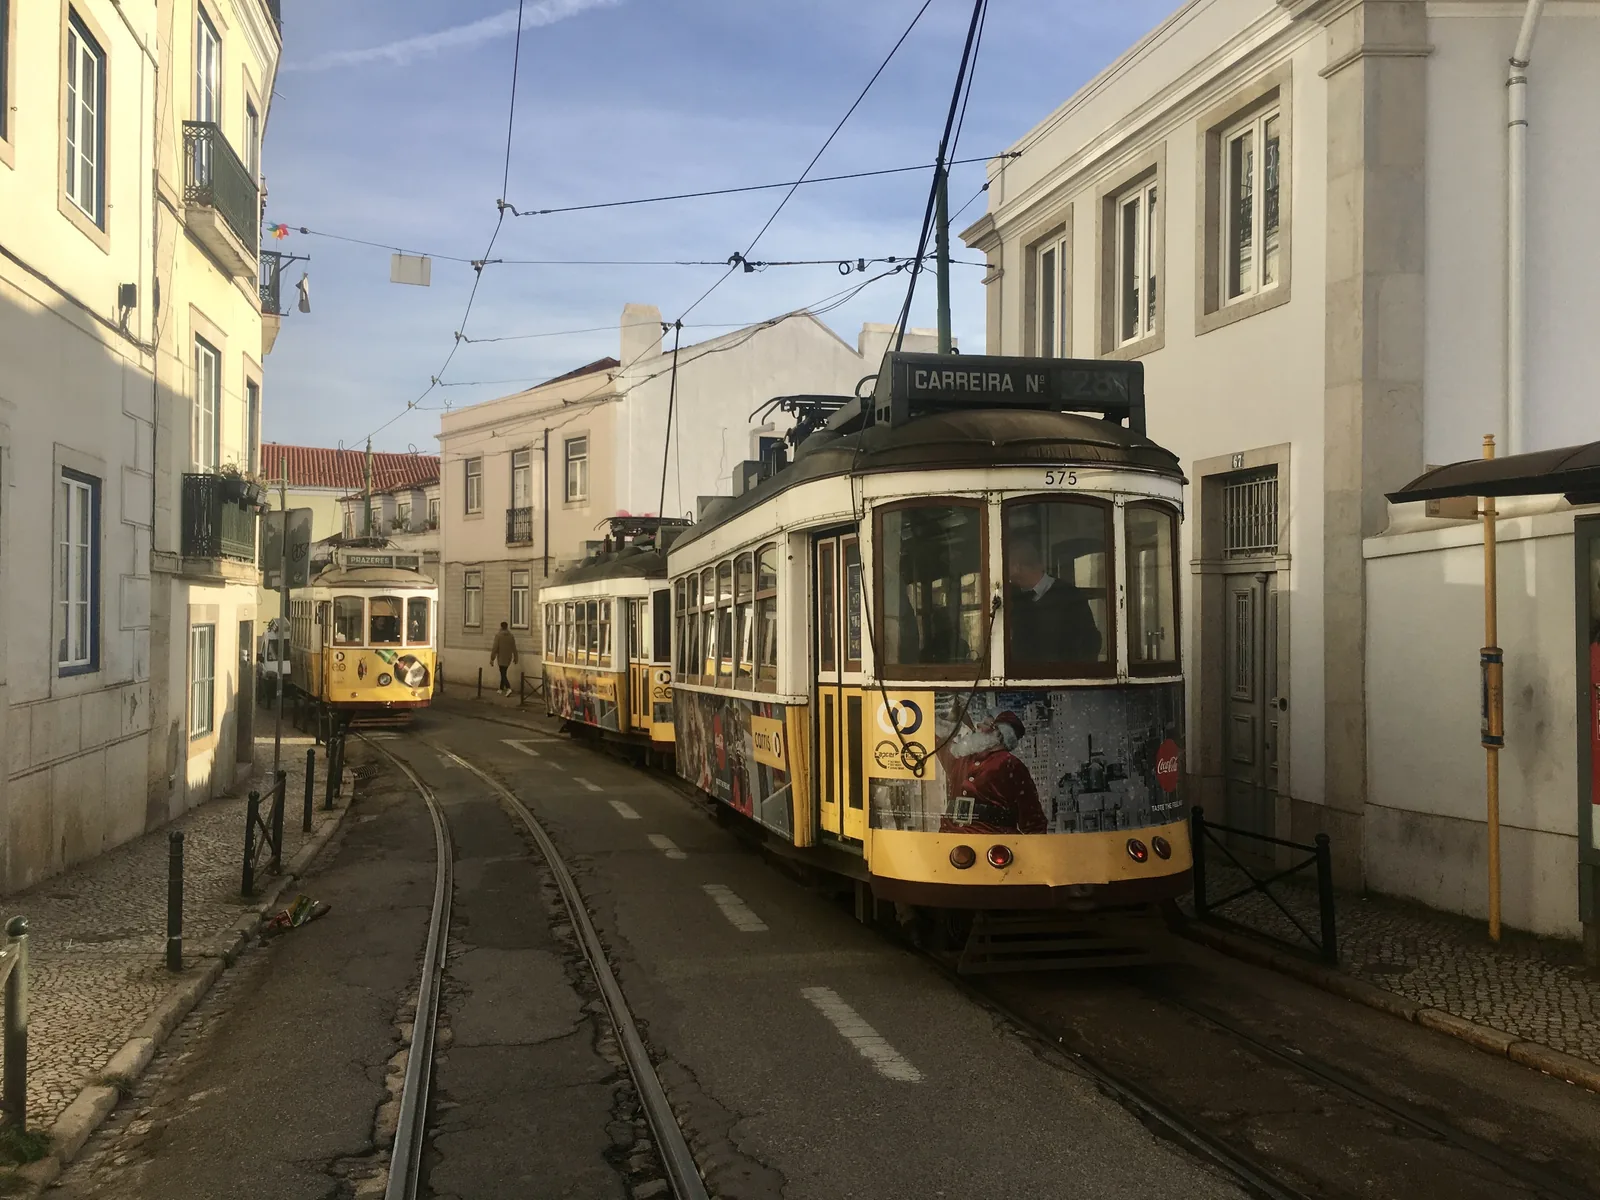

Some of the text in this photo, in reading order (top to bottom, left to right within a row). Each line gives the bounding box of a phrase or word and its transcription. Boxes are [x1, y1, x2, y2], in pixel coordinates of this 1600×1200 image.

[915, 370, 1014, 392] CARREIRA
[1233, 454, 1242, 468] 67
[1045, 471, 1077, 486] 575
[350, 556, 390, 565] PRAZERES
